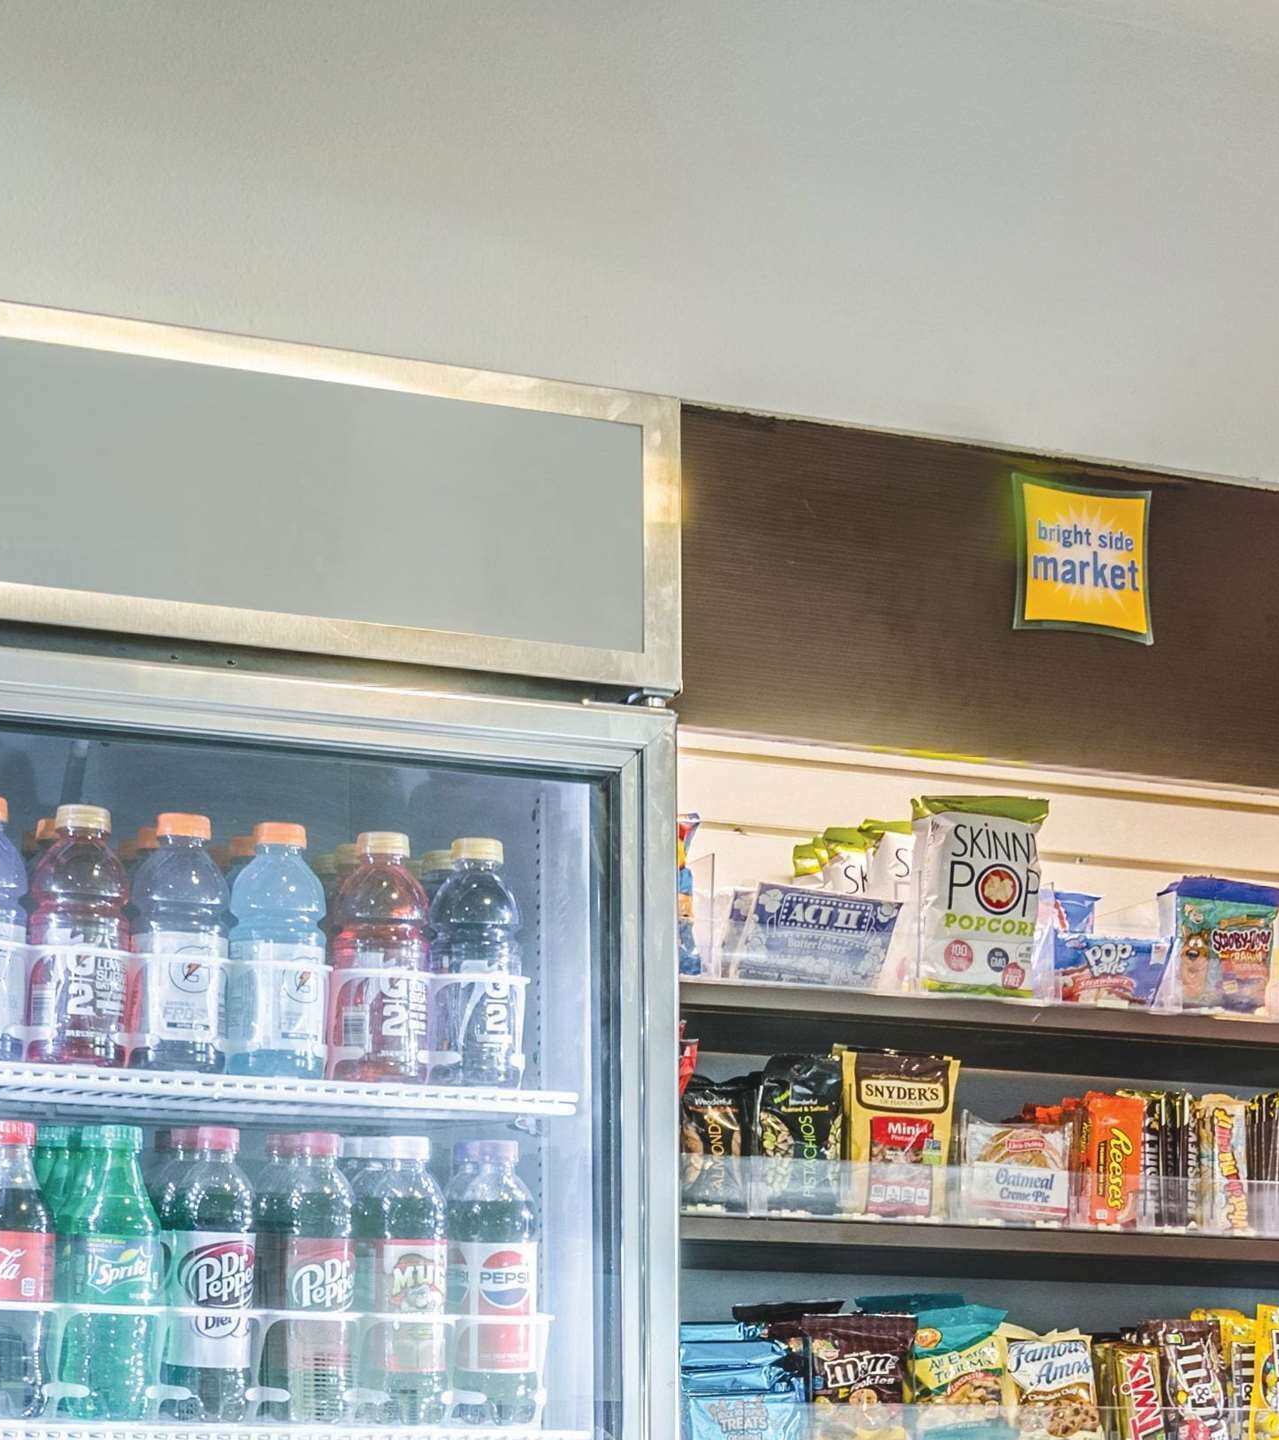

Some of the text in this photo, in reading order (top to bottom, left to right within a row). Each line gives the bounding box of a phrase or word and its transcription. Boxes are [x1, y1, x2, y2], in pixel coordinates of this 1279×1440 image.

[1038, 520, 1134, 551] bright side
[1033, 551, 1139, 591] market
[788, 904, 859, 929] ACT II
[865, 1083, 940, 1101] SNYDER'S
[995, 1170, 1054, 1191] Oatmeal
[1108, 1127, 1133, 1211] Reese's
[999, 1188, 1030, 1200] Creme
[95, 1258, 149, 1286] Sprite
[220, 1252, 248, 1278] Dr
[325, 1259, 351, 1283] Dr
[480, 1271, 530, 1284] PEPSI
[1008, 1341, 1089, 1371] Famous
[1029, 1358, 1091, 1386] Amos
[720, 1416, 769, 1432] TREATS
